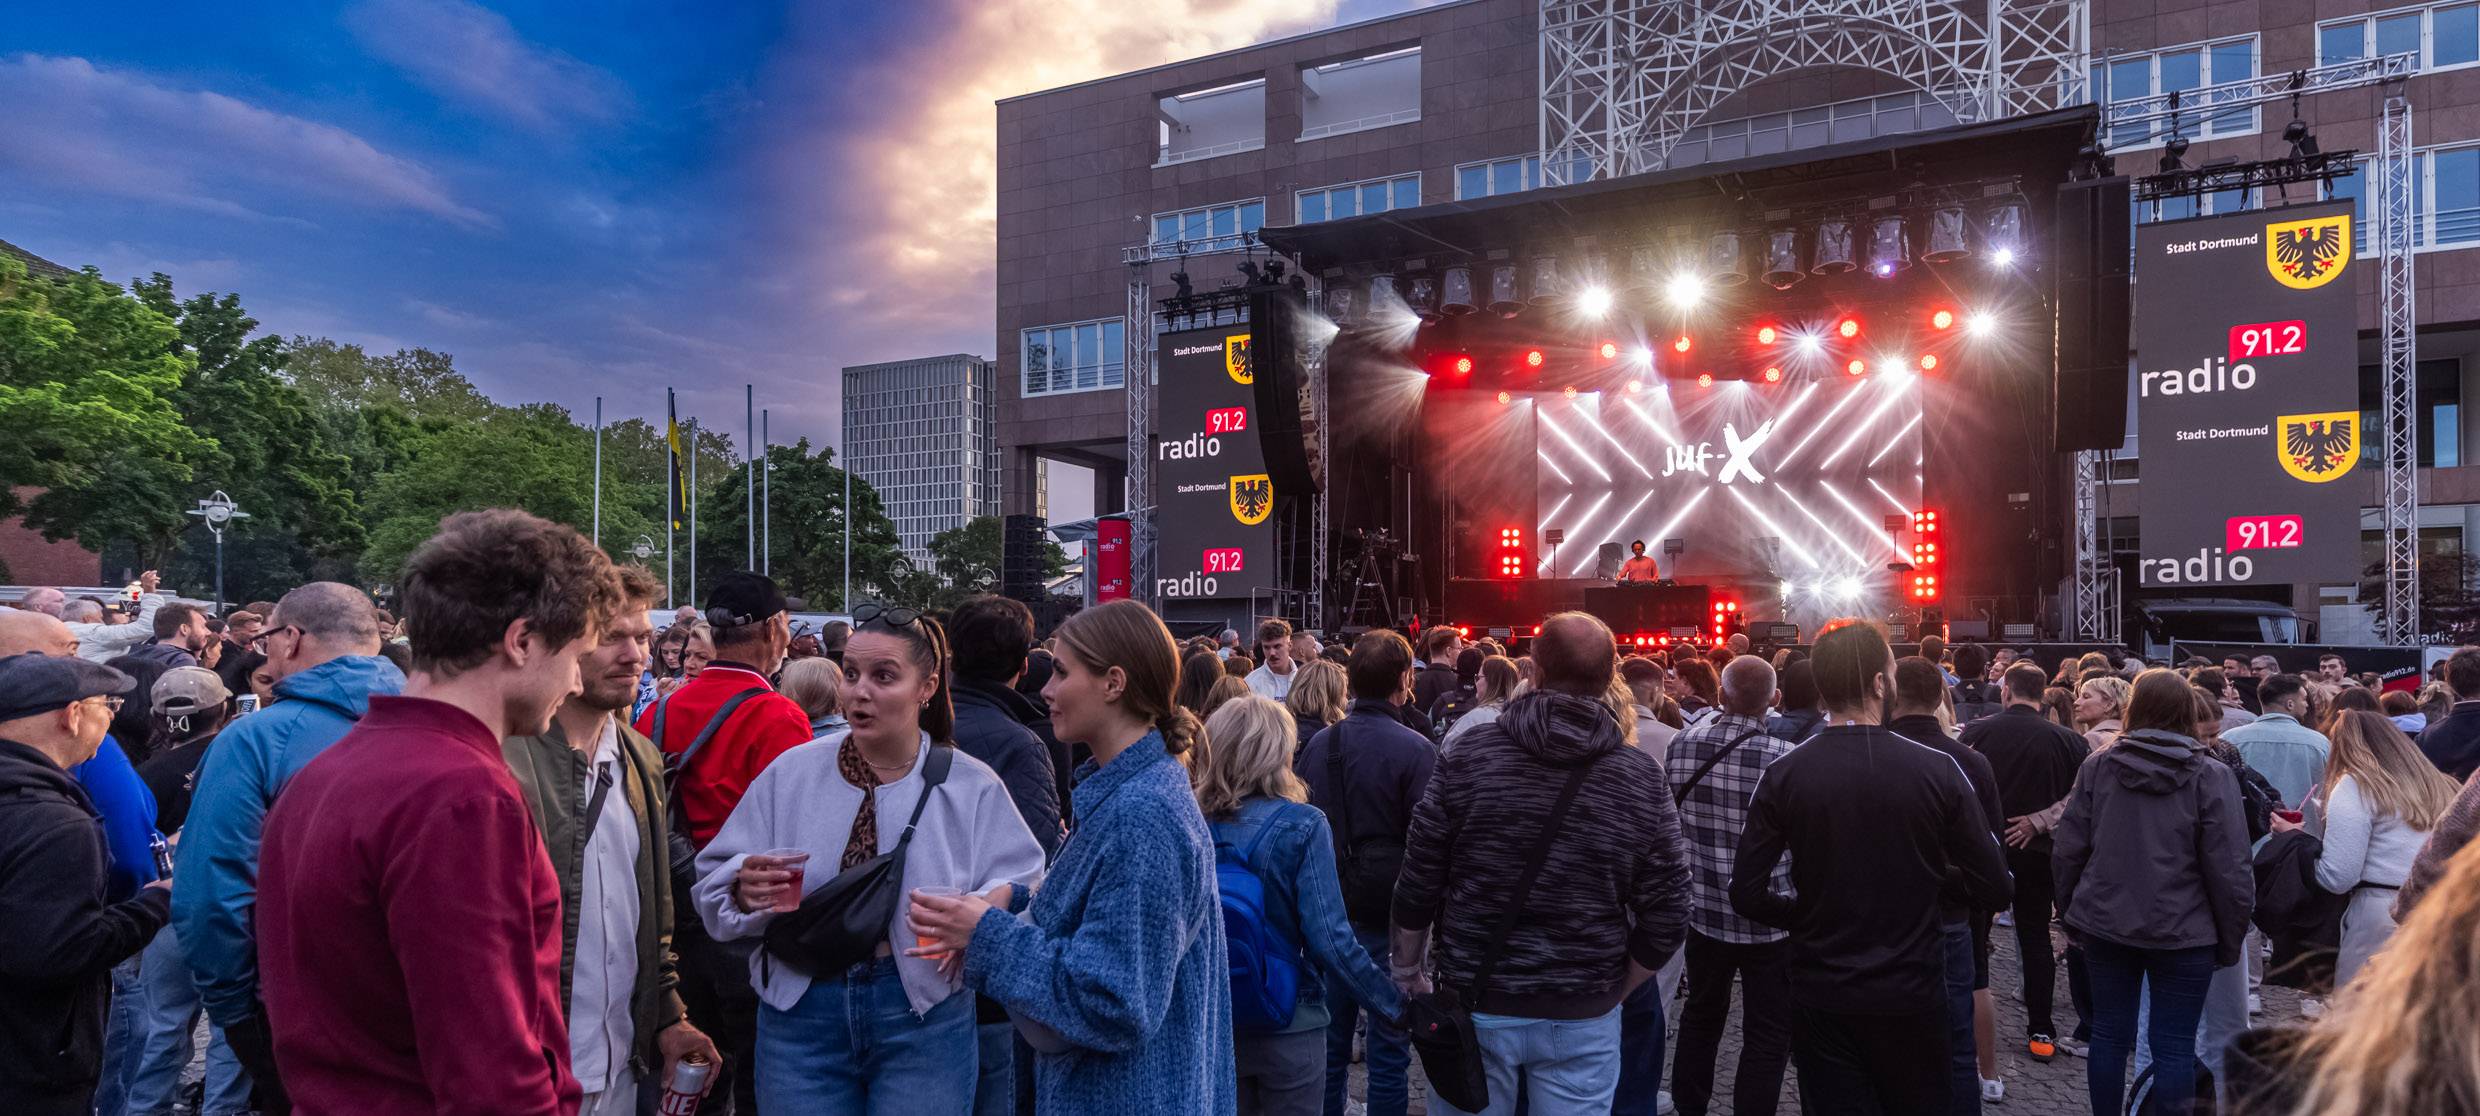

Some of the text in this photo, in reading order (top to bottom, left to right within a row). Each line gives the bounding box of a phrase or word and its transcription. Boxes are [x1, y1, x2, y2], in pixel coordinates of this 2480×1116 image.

[2166, 233, 2259, 254] Stadt Dortmund
[1173, 342, 1223, 356] Stadt Dortmund
[2141, 325, 2302, 398] radio 91.2
[1159, 410, 1244, 461] radio 91.2
[2176, 424, 2269, 441] Stadt Dortmund
[1177, 482, 1227, 493] Stadt Dortmund
[2139, 519, 2299, 584] radio 91.2
[1157, 551, 1242, 597] radio 91.2
